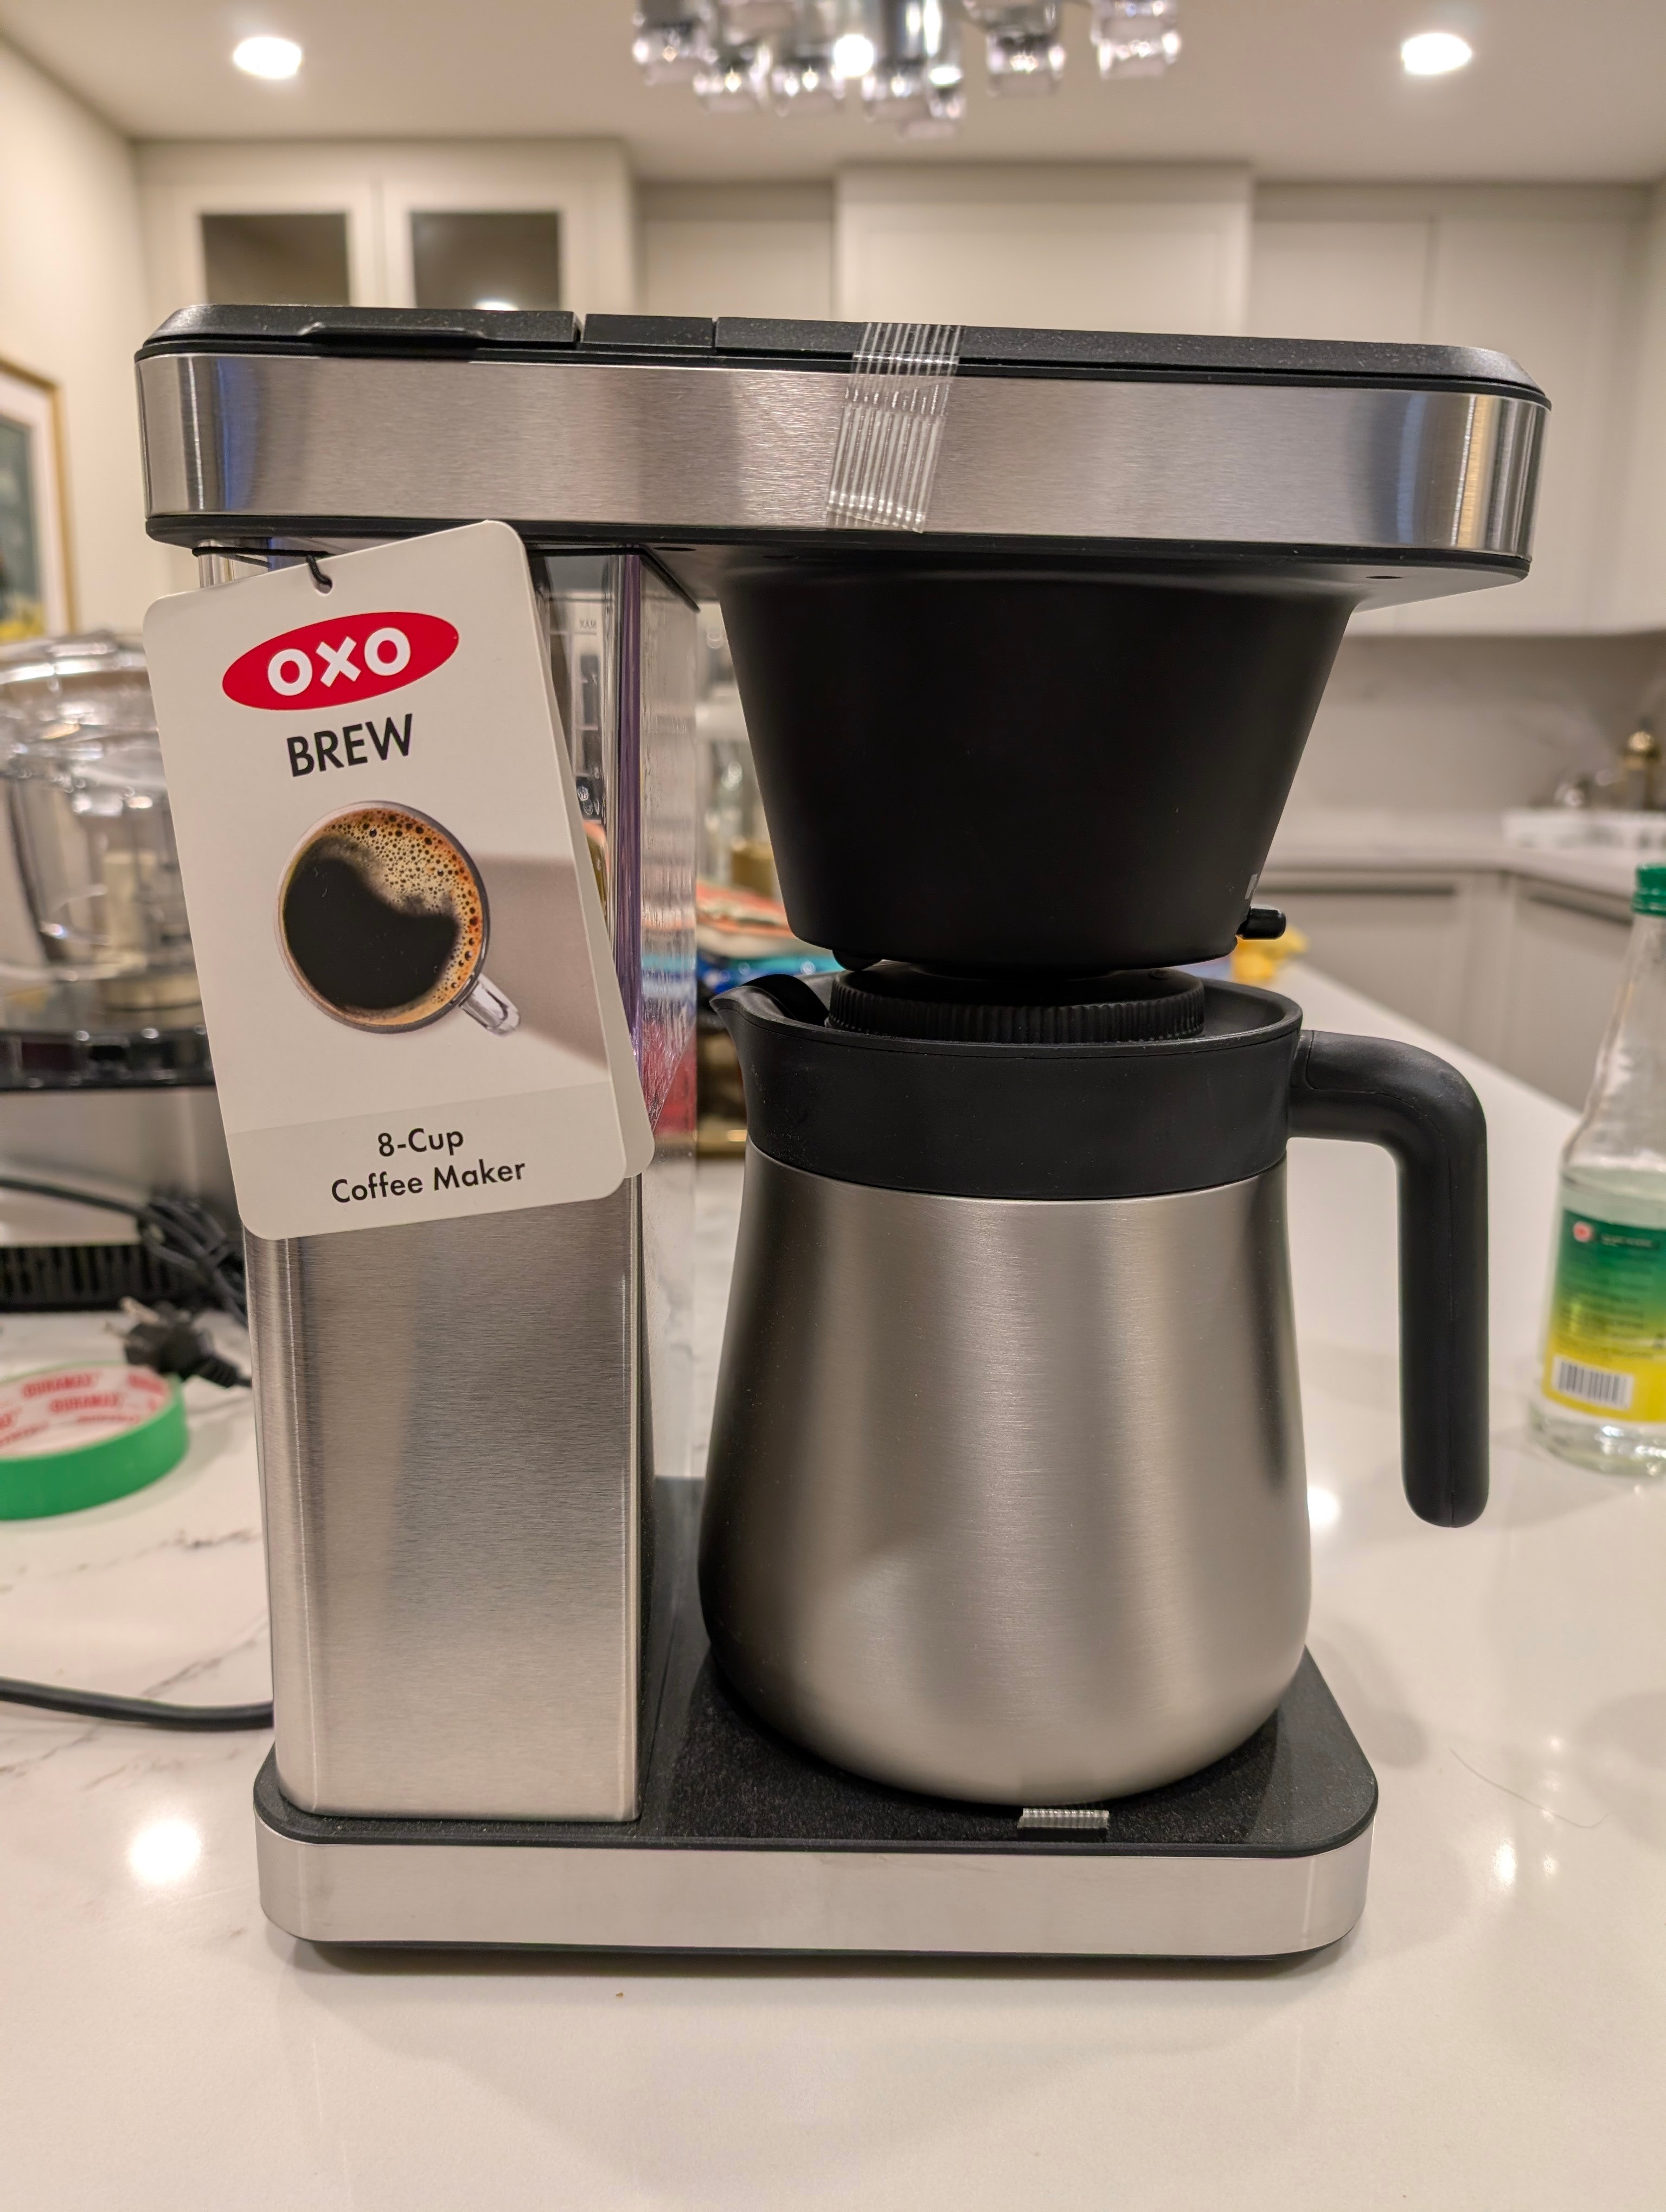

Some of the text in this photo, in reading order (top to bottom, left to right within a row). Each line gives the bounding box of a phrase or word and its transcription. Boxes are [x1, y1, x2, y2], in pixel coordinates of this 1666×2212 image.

[267, 627, 412, 697] OXO
[286, 713, 413, 777] BREW
[377, 1127, 464, 1157] 8-Cup
[331, 1159, 526, 1203] Coffee Maker
